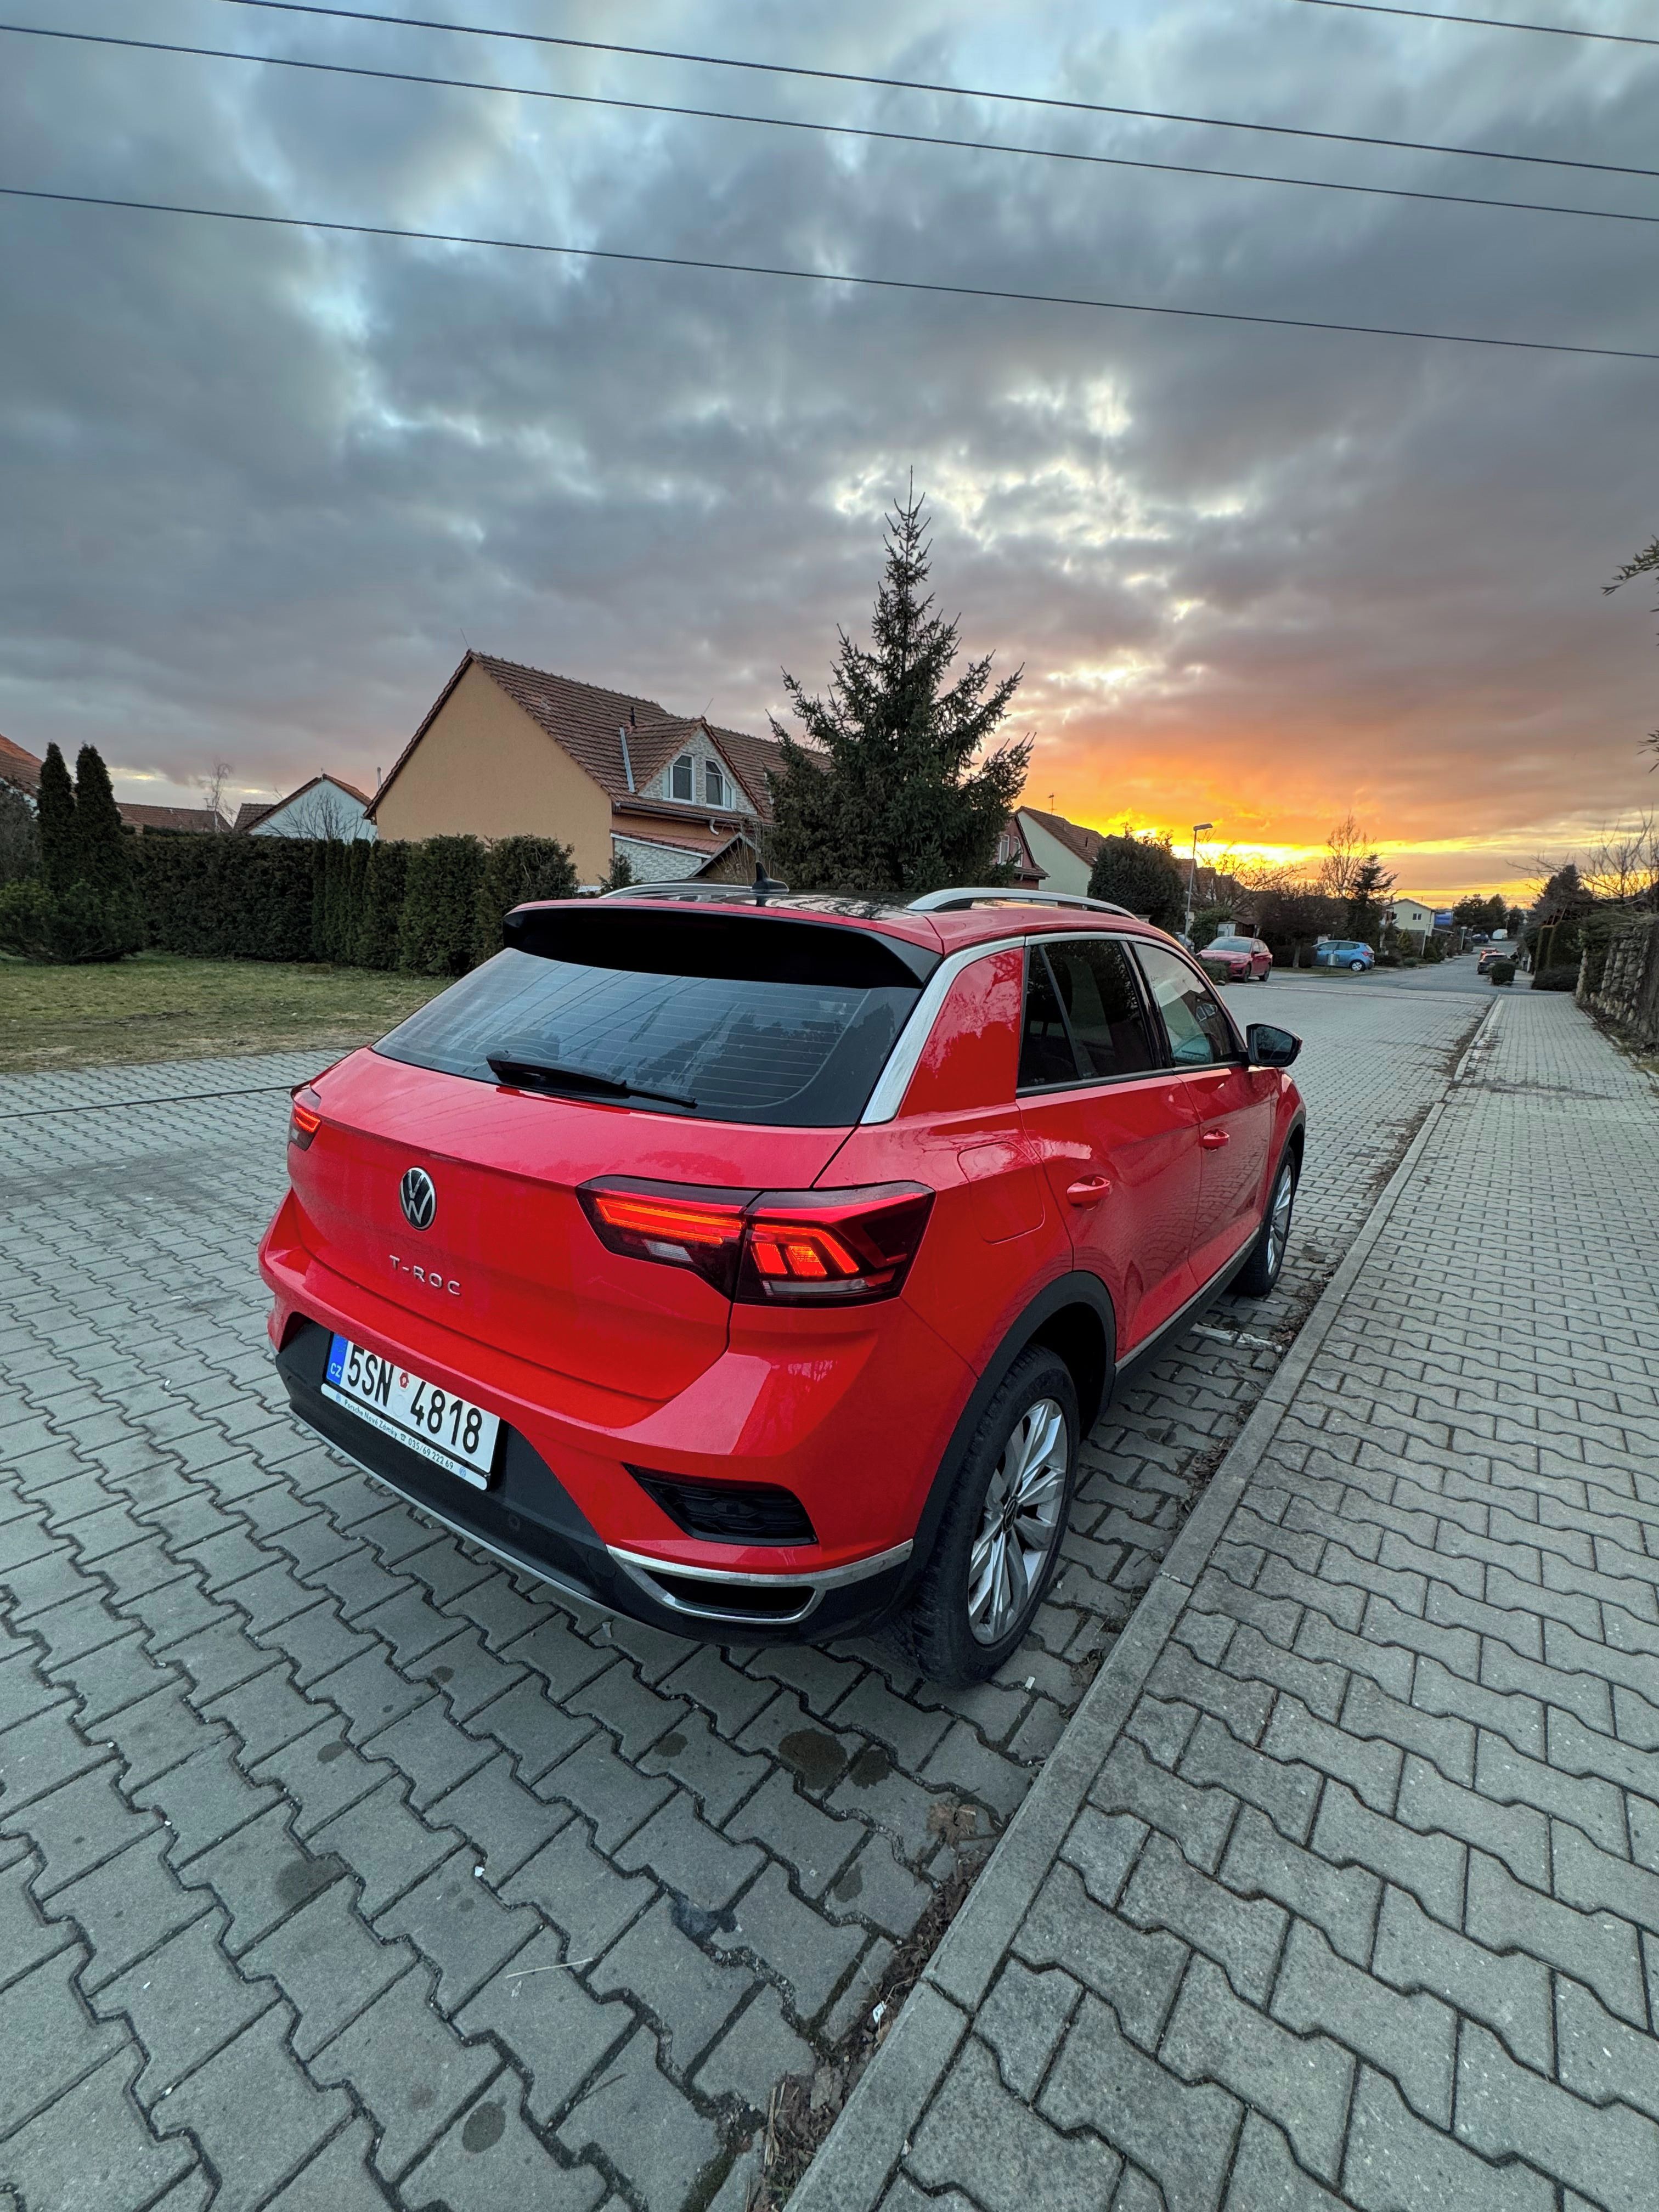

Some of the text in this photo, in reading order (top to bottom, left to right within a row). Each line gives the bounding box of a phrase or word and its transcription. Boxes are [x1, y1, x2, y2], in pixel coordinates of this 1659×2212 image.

[400, 1167, 436, 1229] VW
[389, 1255, 460, 1295] T-ROC
[330, 1362, 342, 1379] CZ
[347, 1344, 482, 1454] 5SN 4818
[345, 1399, 363, 1415] Porsche
[364, 1412, 378, 1425] Nové
[408, 1438, 431, 1456] 035/69
[432, 1452, 444, 1465] 222
[445, 1460, 454, 1470] 69
